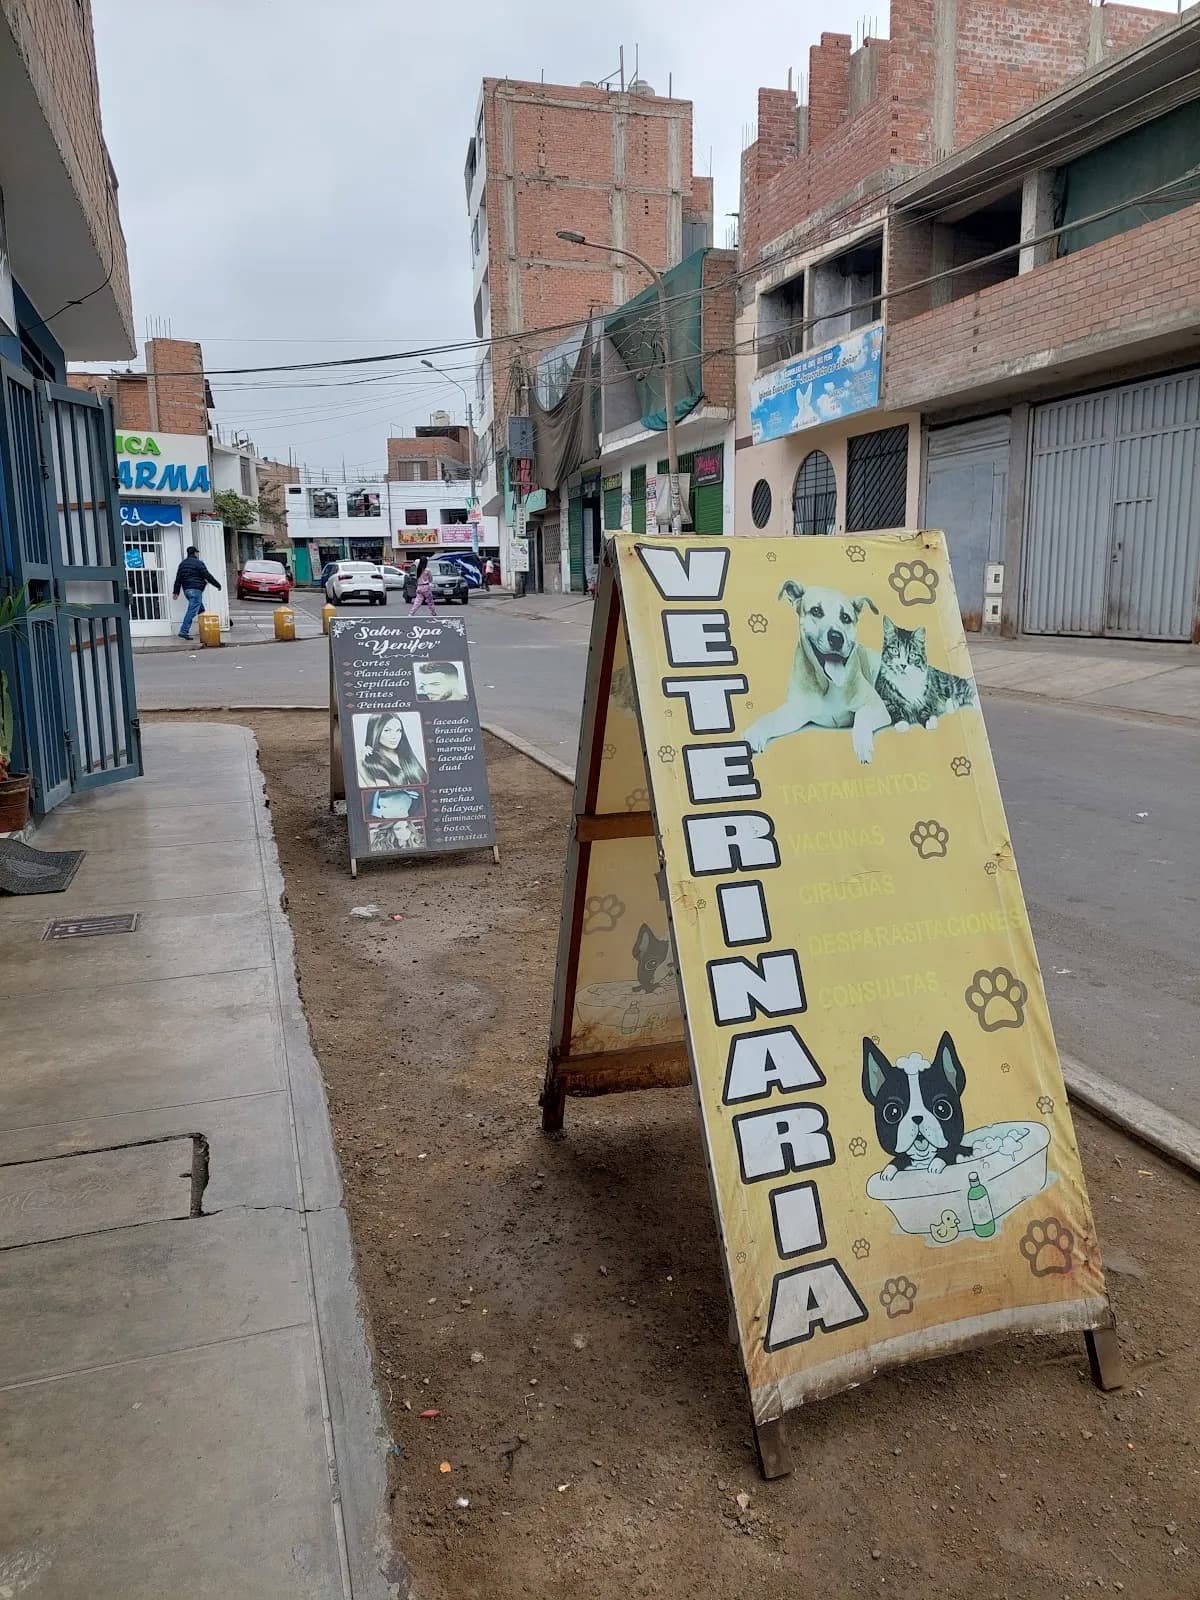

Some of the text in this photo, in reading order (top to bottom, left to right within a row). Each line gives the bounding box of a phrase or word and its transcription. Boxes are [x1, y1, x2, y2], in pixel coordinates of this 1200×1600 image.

[354, 625, 443, 640] Salon Spa
[353, 659, 391, 668] Cortes
[353, 668, 412, 678] Planchados
[353, 679, 410, 690] Sepillado
[356, 690, 394, 699] Tintes
[357, 699, 412, 709] Peinados
[432, 716, 469, 726] laceado
[434, 725, 474, 735] brasilero
[435, 734, 472, 744] laceado
[437, 752, 474, 762] laceado
[438, 762, 465, 772] dual
[438, 785, 473, 796] rayitos
[780, 771, 932, 805] TRATAMIENTOS
[440, 794, 475, 804] mechas
[441, 803, 485, 814] balayage
[443, 824, 473, 833] botox
[788, 825, 885, 853] VACUNAS
[808, 907, 1022, 955] DESPARASITACIONES
[634, 543, 869, 1354] VETERINARIA
[817, 970, 941, 1008] CONSULTAS
